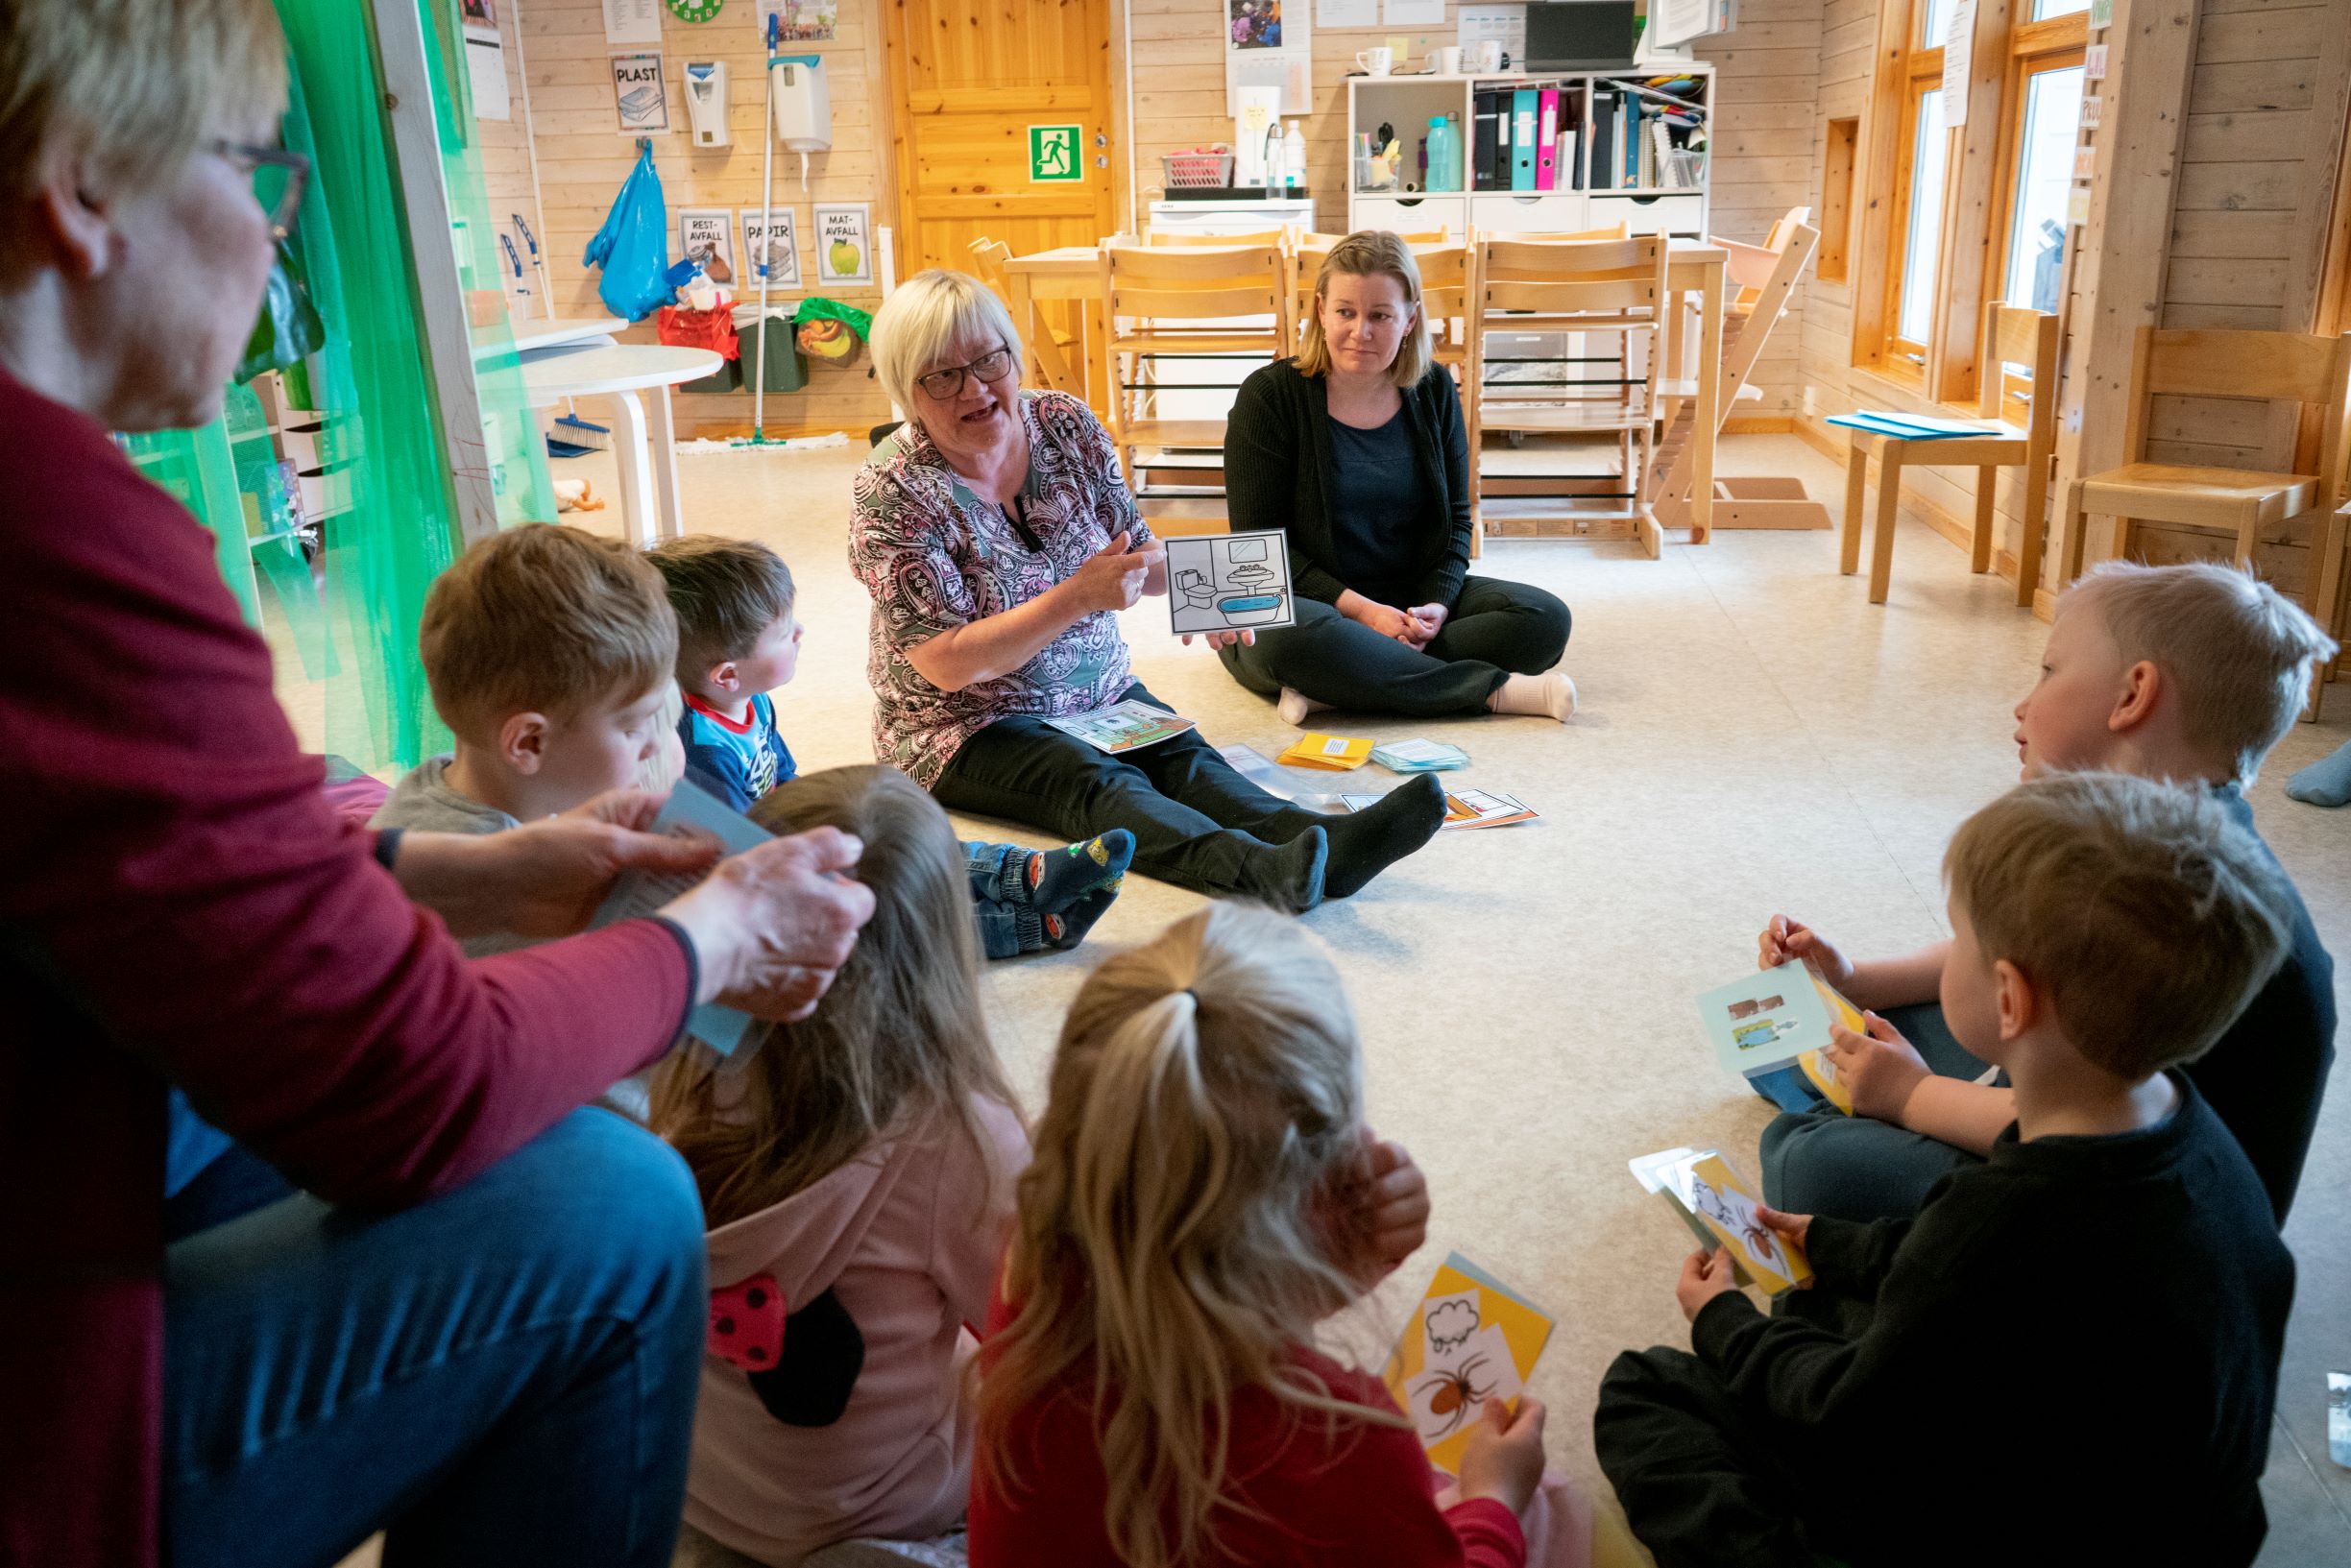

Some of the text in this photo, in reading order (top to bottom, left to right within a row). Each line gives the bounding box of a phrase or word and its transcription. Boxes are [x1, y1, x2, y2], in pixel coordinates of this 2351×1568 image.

[617, 67, 656, 83] PLAST
[692, 220, 718, 229] REST-
[829, 215, 853, 225] MAT-
[690, 231, 722, 241] AVFALL
[826, 226, 859, 236] AVFALL
